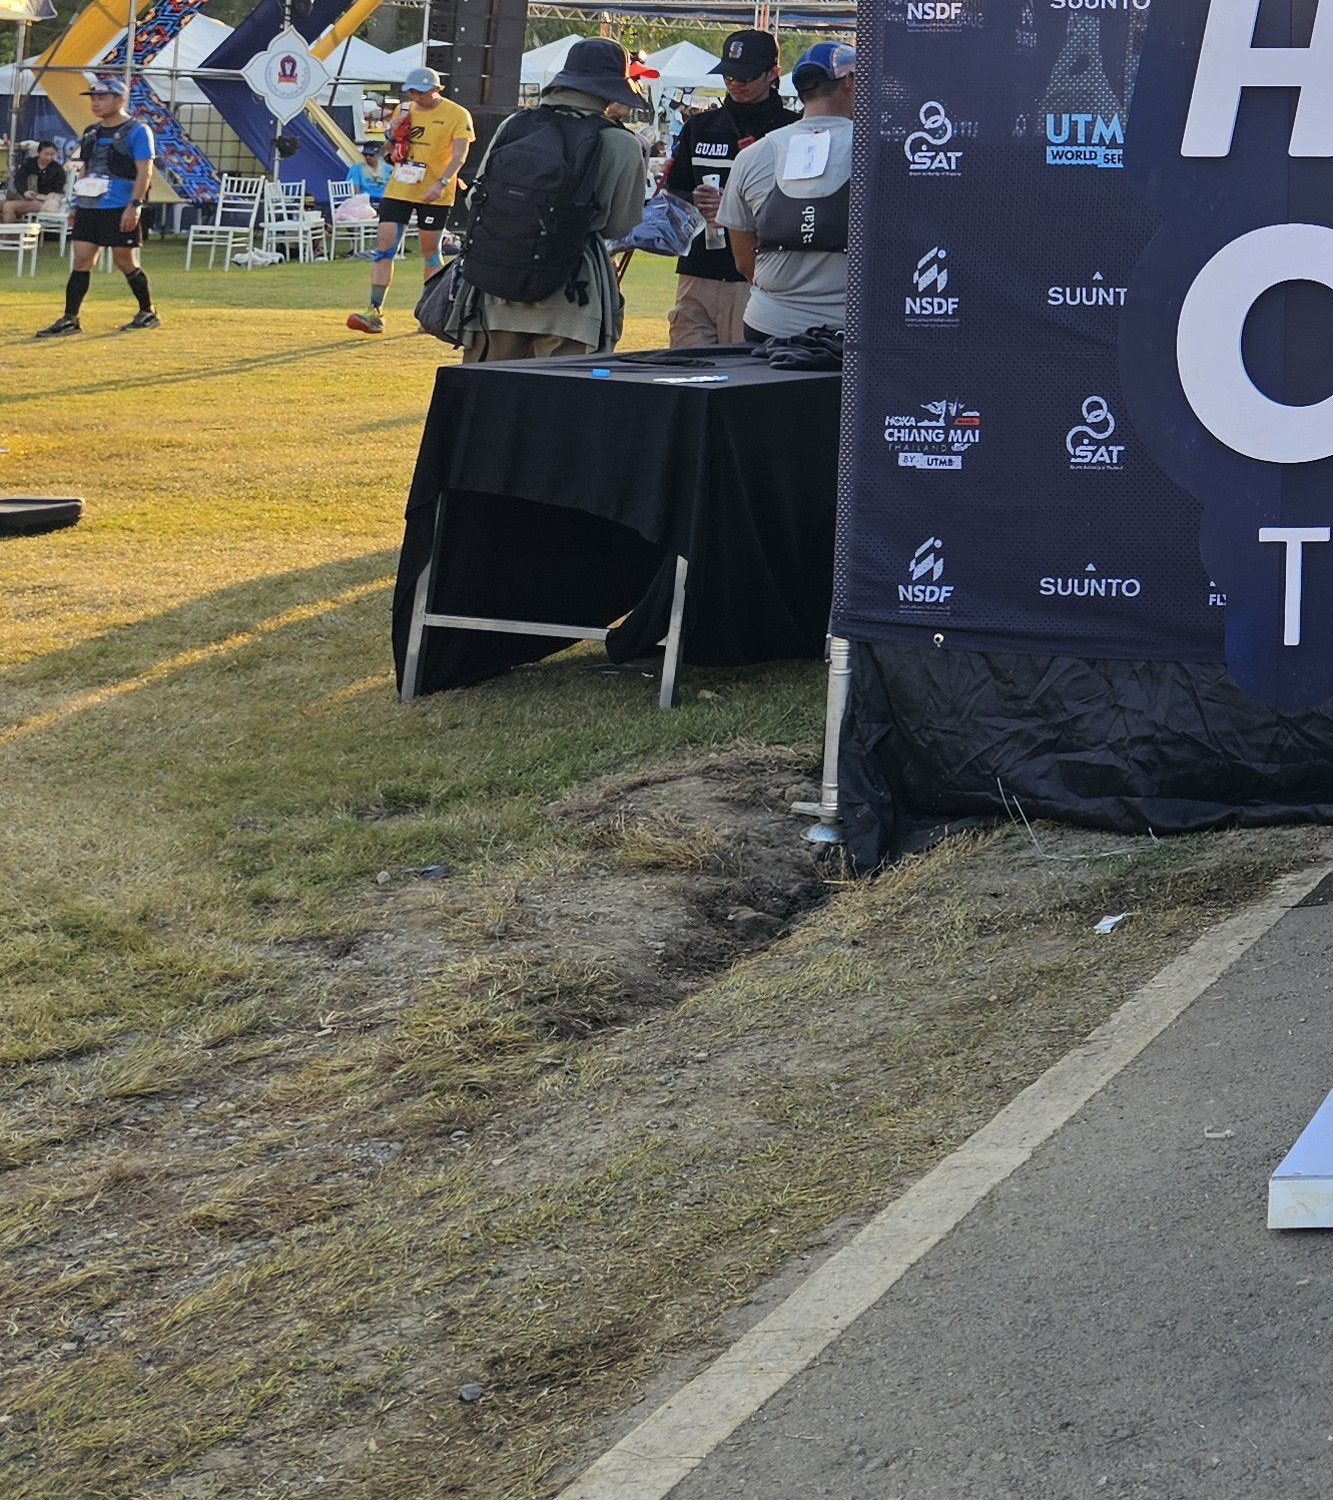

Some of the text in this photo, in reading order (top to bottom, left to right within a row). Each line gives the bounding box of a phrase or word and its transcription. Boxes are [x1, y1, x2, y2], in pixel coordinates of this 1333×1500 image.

[906, 2, 963, 20] NSDF
[695, 142, 729, 157] GUARD
[1050, 150, 1099, 162] WORLD
[909, 151, 963, 171] SAT
[800, 205, 816, 233] Rab
[904, 296, 960, 315] NSDF
[884, 415, 916, 427] HOKA
[884, 428, 980, 443] CHIANG MAI
[902, 456, 954, 467] BY UTMB
[1070, 445, 1126, 464] SAT
[898, 584, 955, 603] NSDF
[1039, 577, 1142, 597] SUUNTO
